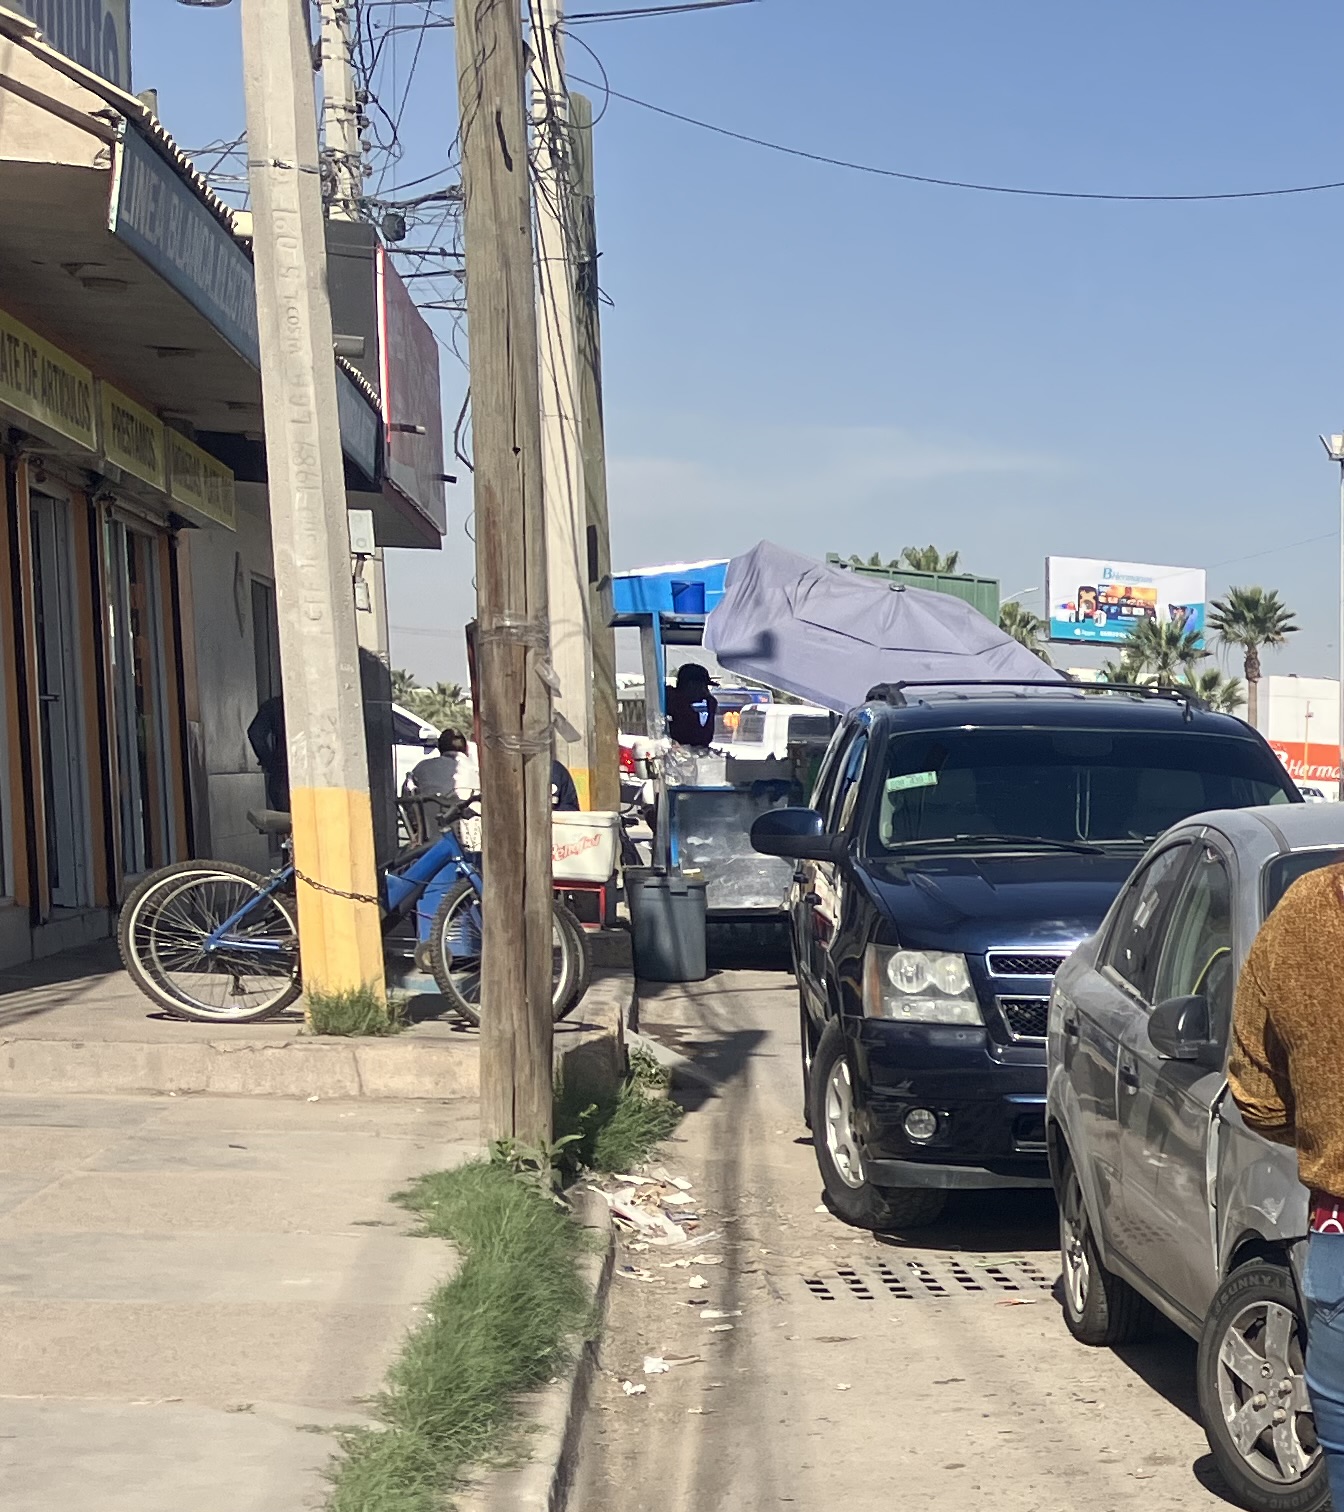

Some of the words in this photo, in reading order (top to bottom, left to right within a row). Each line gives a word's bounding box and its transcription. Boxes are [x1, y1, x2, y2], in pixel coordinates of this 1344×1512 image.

[121, 148, 166, 250] LINEA
[167, 194, 215, 294] BLANCA
[23, 342, 39, 402] DE
[41, 359, 91, 434] ARTICULOS
